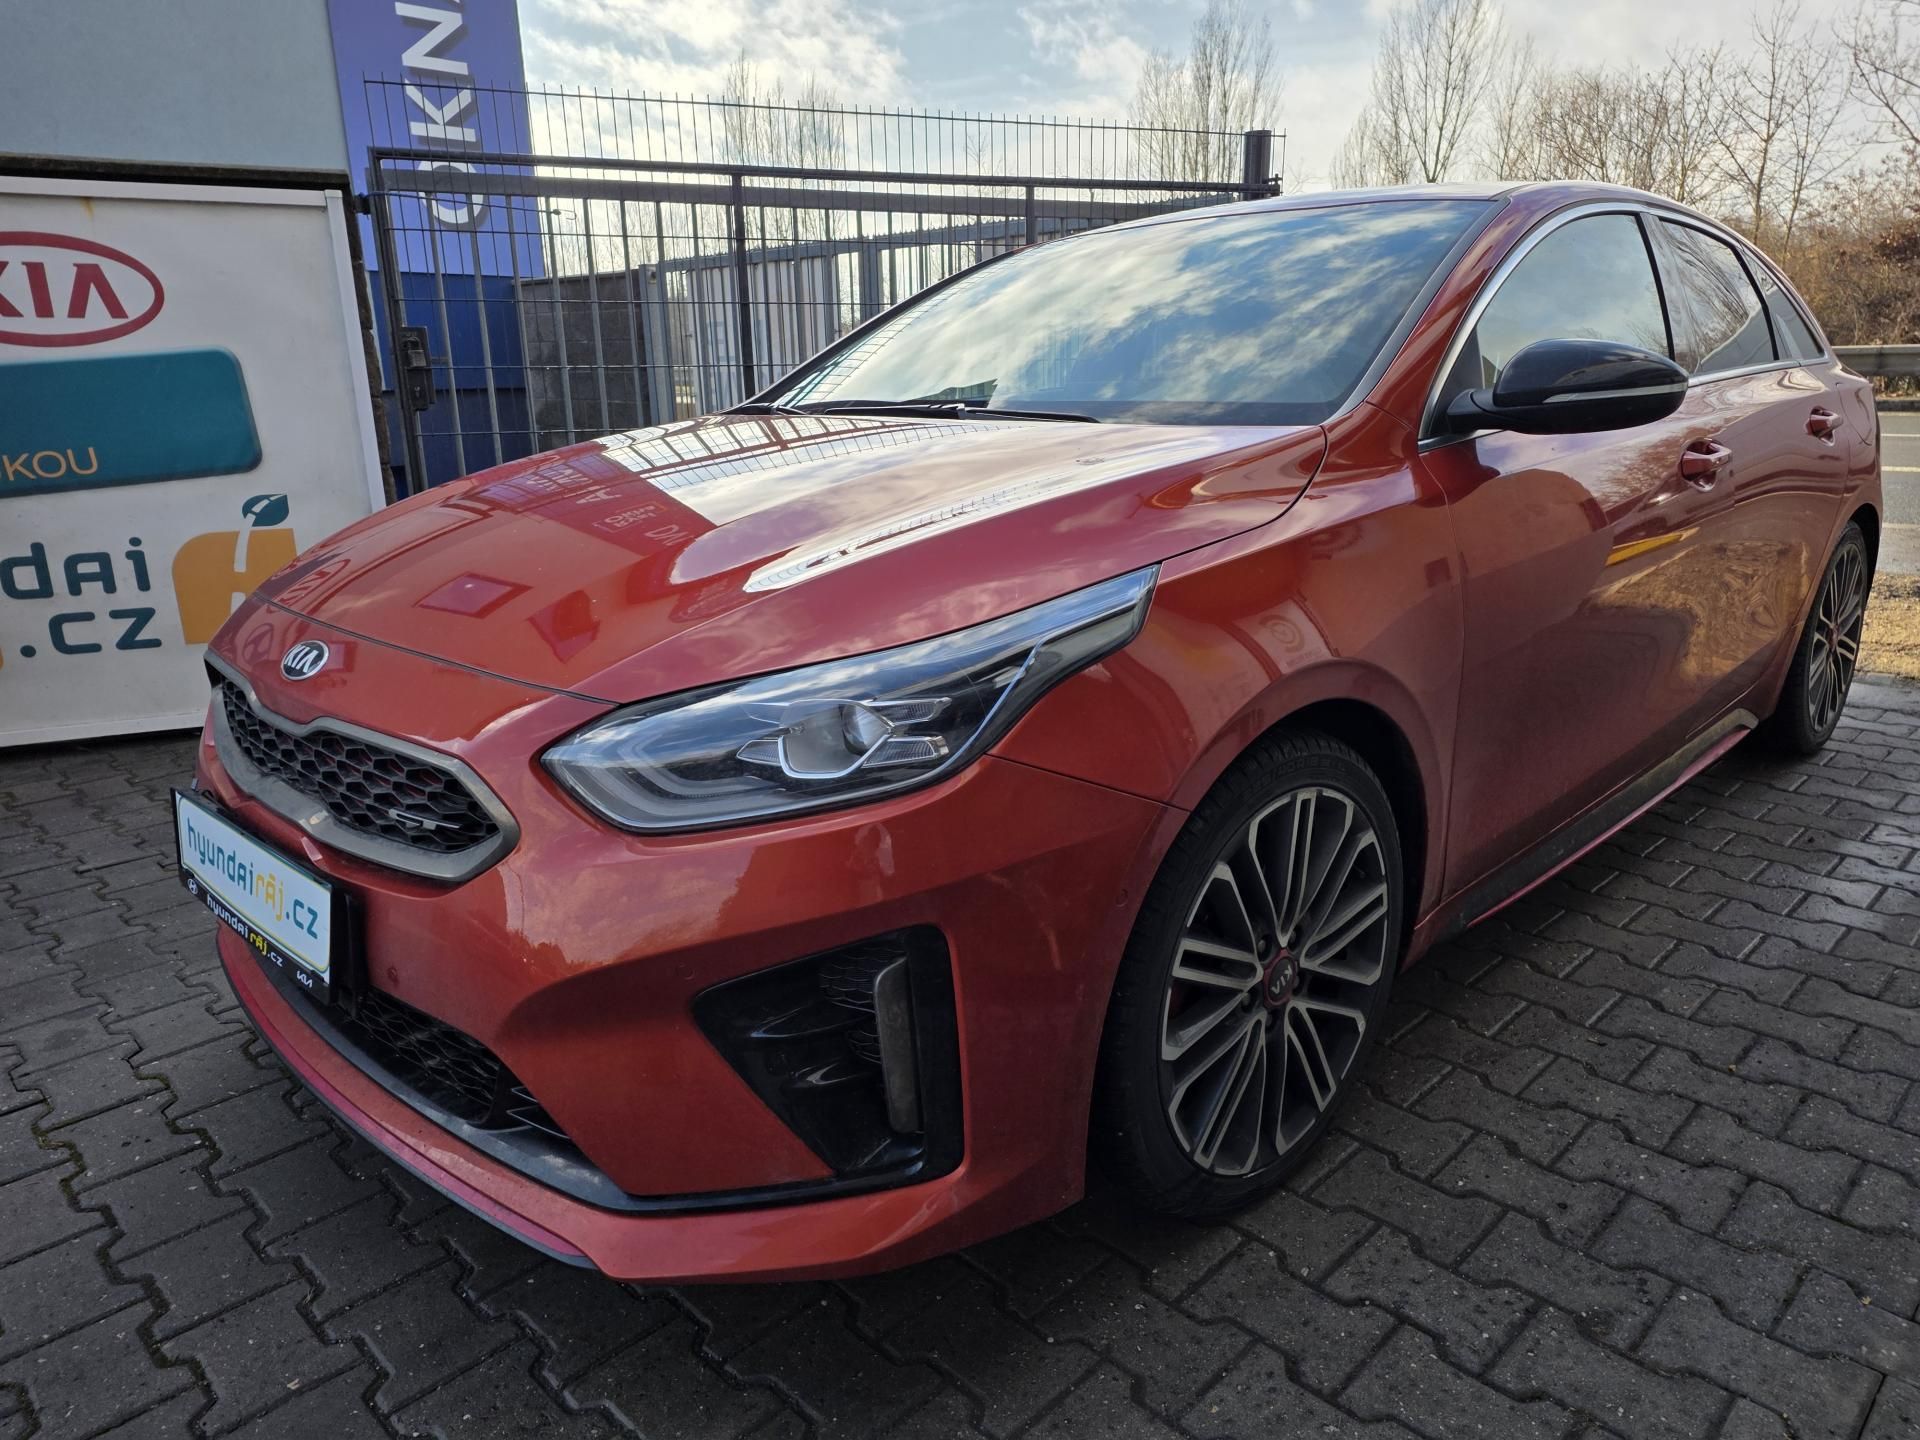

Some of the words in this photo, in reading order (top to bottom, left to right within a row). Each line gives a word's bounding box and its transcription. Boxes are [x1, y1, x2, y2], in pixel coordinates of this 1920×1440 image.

[394, 0, 485, 224] OKN
[0, 447, 98, 482] KOU
[0, 607, 162, 670] .cz
[284, 644, 320, 674] KIA
[1271, 963, 1294, 995] KIA
